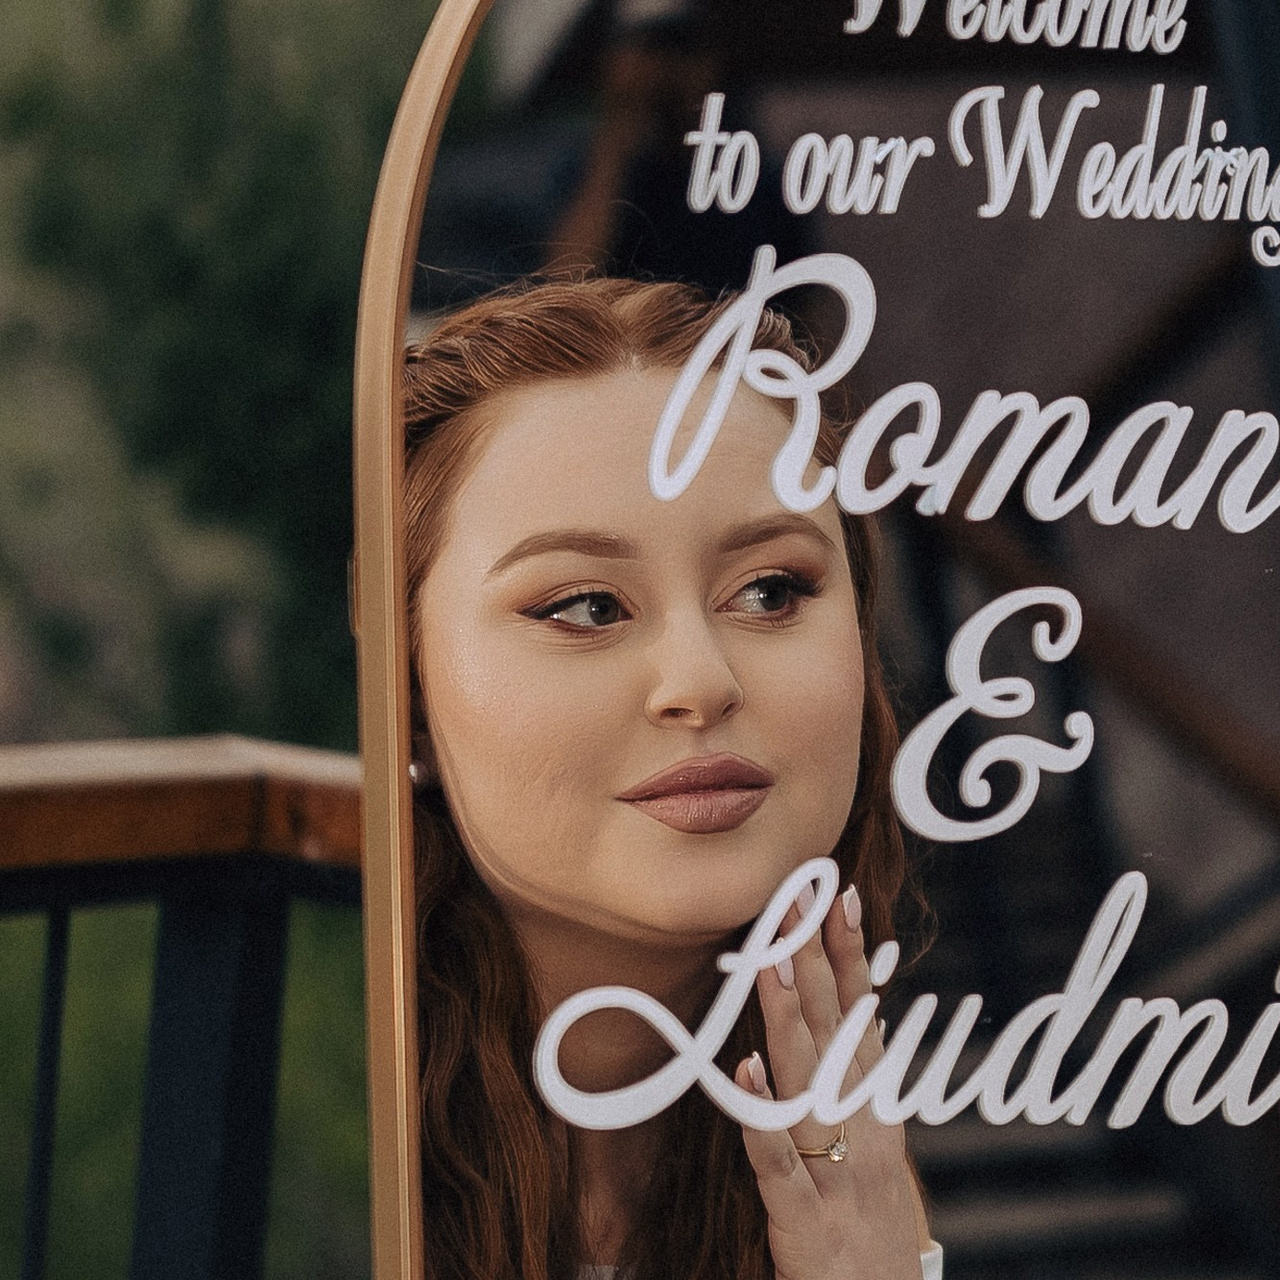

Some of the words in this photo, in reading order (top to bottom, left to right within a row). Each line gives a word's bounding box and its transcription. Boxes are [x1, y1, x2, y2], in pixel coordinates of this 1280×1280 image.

[684, 92, 760, 214] to
[783, 132, 936, 215] our
[891, 586, 1095, 842] &
